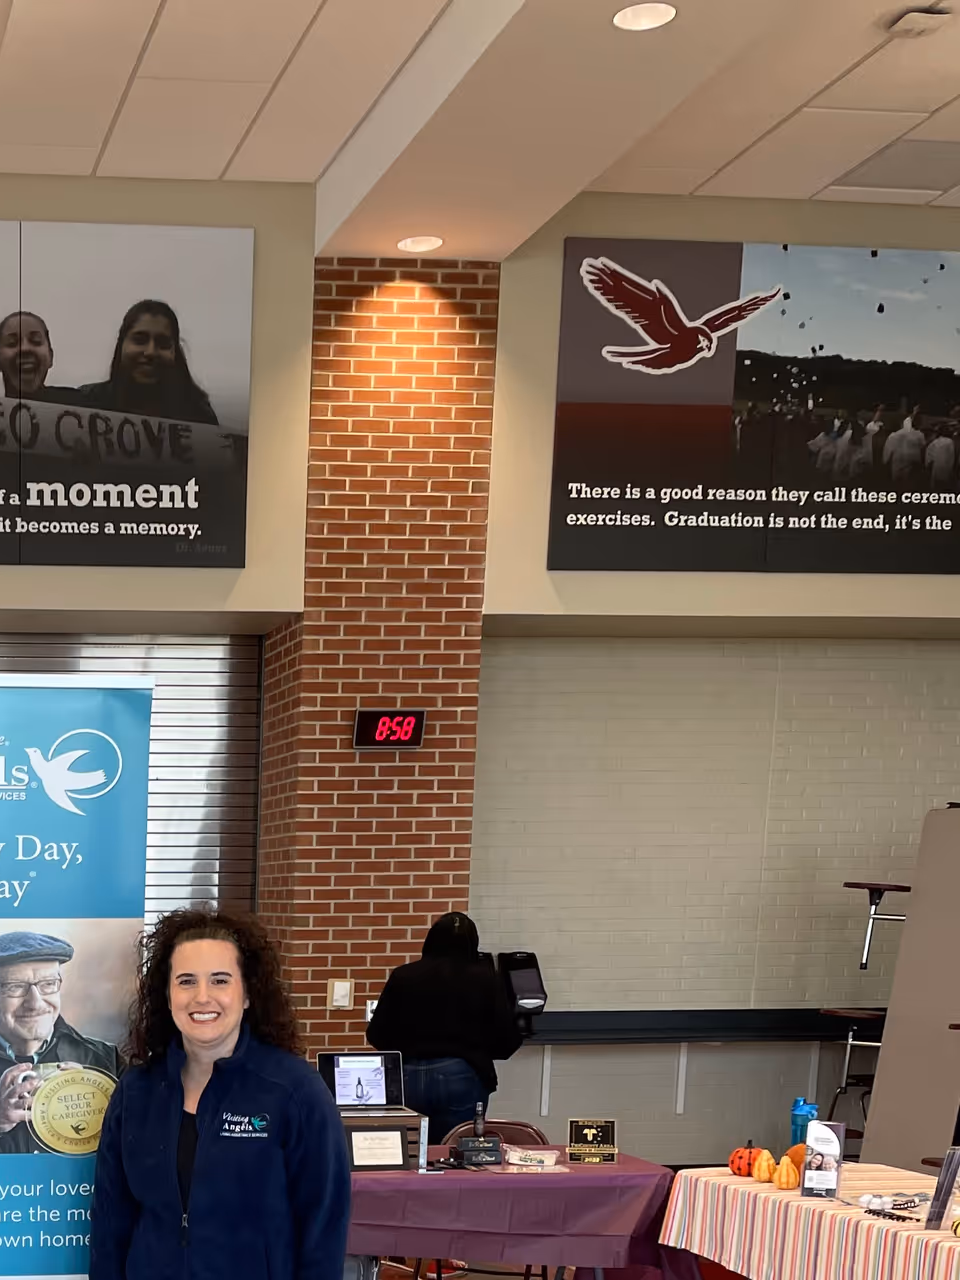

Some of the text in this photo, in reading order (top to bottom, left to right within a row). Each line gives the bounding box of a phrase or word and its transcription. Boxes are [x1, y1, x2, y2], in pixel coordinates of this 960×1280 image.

[8, 493, 21, 506] a
[26, 477, 199, 509] moment
[568, 483, 620, 499] There
[626, 483, 640, 500] is
[645, 488, 656, 500] a
[660, 484, 703, 503] good
[707, 488, 767, 501] reason
[771, 486, 809, 505] they
[813, 486, 846, 502] call
[850, 487, 897, 504] these
[15, 517, 99, 537] becomes
[104, 523, 115, 536] a
[119, 520, 201, 539] memory.
[566, 510, 952, 532] exercises. Graduation is not the end, it's the
[375, 716, 416, 741] 8:58
[15, 834, 83, 869] Day,
[57, 1091, 97, 1104] SELECT
[64, 1102, 91, 1111] YOUR
[223, 1122, 253, 1132] Angels
[50, 1179, 95, 1196] love
[28, 1206, 61, 1222] the
